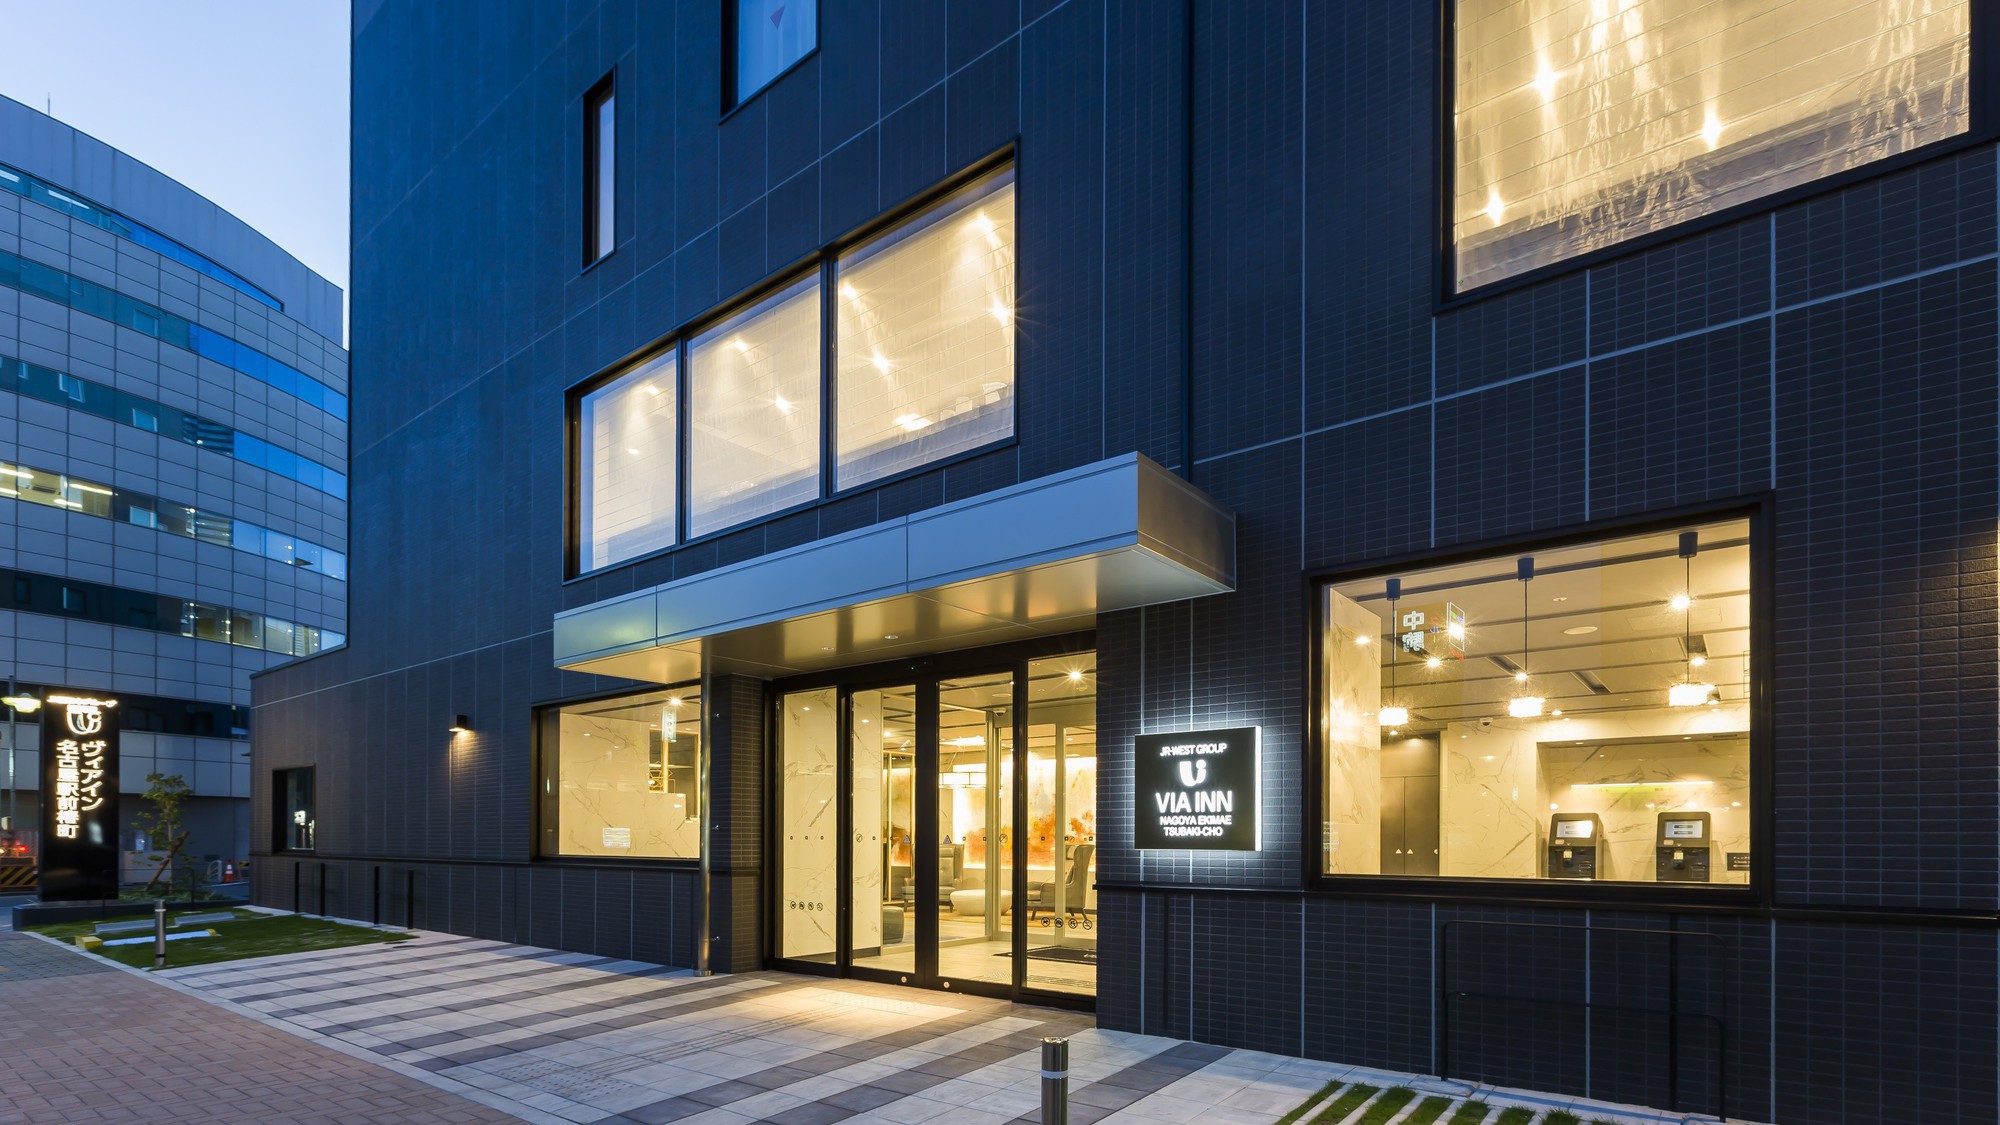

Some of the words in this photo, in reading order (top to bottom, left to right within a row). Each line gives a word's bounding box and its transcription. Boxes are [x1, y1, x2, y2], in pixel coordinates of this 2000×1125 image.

[1159, 744, 1196, 757] JR-WEST
[1196, 742, 1227, 755] GROUP
[80, 740, 107, 811] ヴィアイン
[1155, 791, 1192, 813] VIA
[1194, 790, 1233, 813] INN
[1159, 815, 1197, 826] NAGOYA
[1197, 814, 1232, 825] EKIMAE
[1163, 826, 1223, 837] TSUBAKI-CHO
